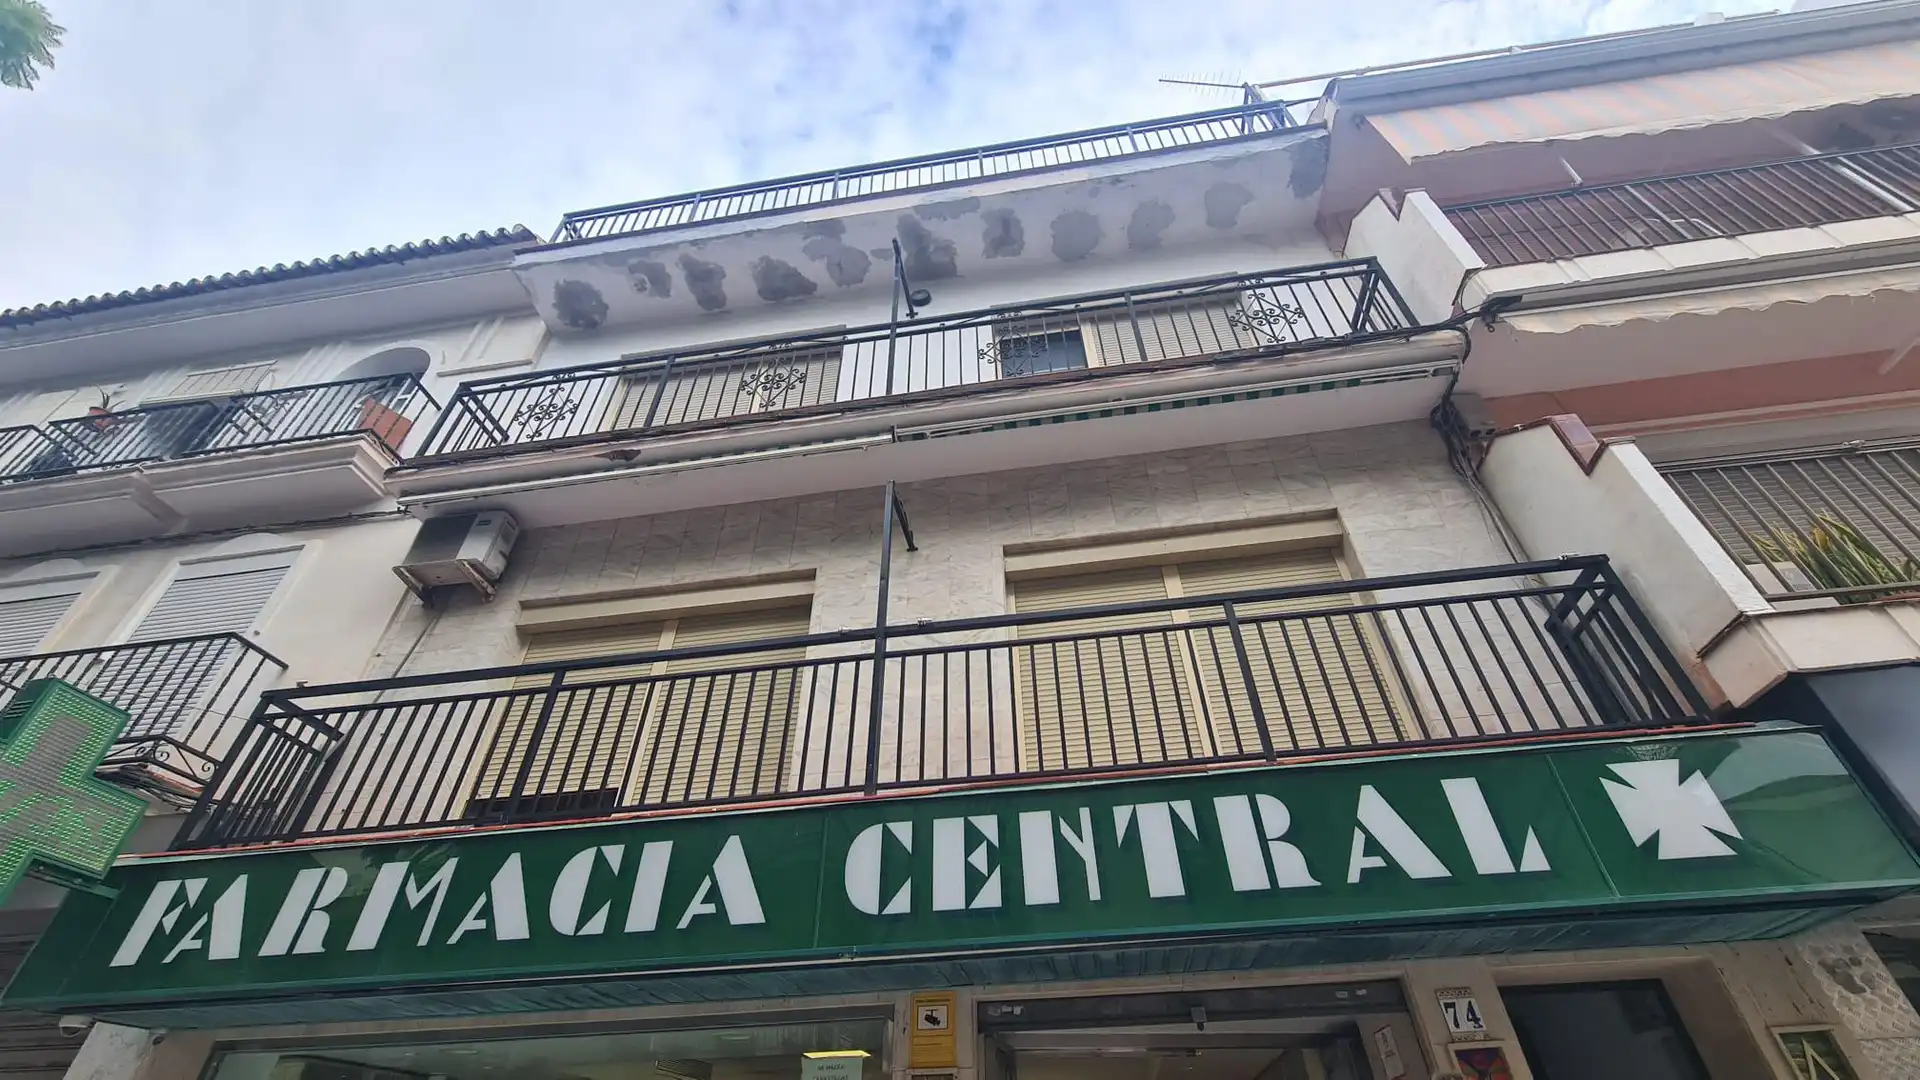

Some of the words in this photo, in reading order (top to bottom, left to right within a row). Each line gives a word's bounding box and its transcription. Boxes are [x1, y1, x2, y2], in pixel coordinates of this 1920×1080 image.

[110, 835, 766, 967] FARMACIA
[845, 777, 1551, 915] CENTRAL
[1443, 1000, 1484, 1029] 74
